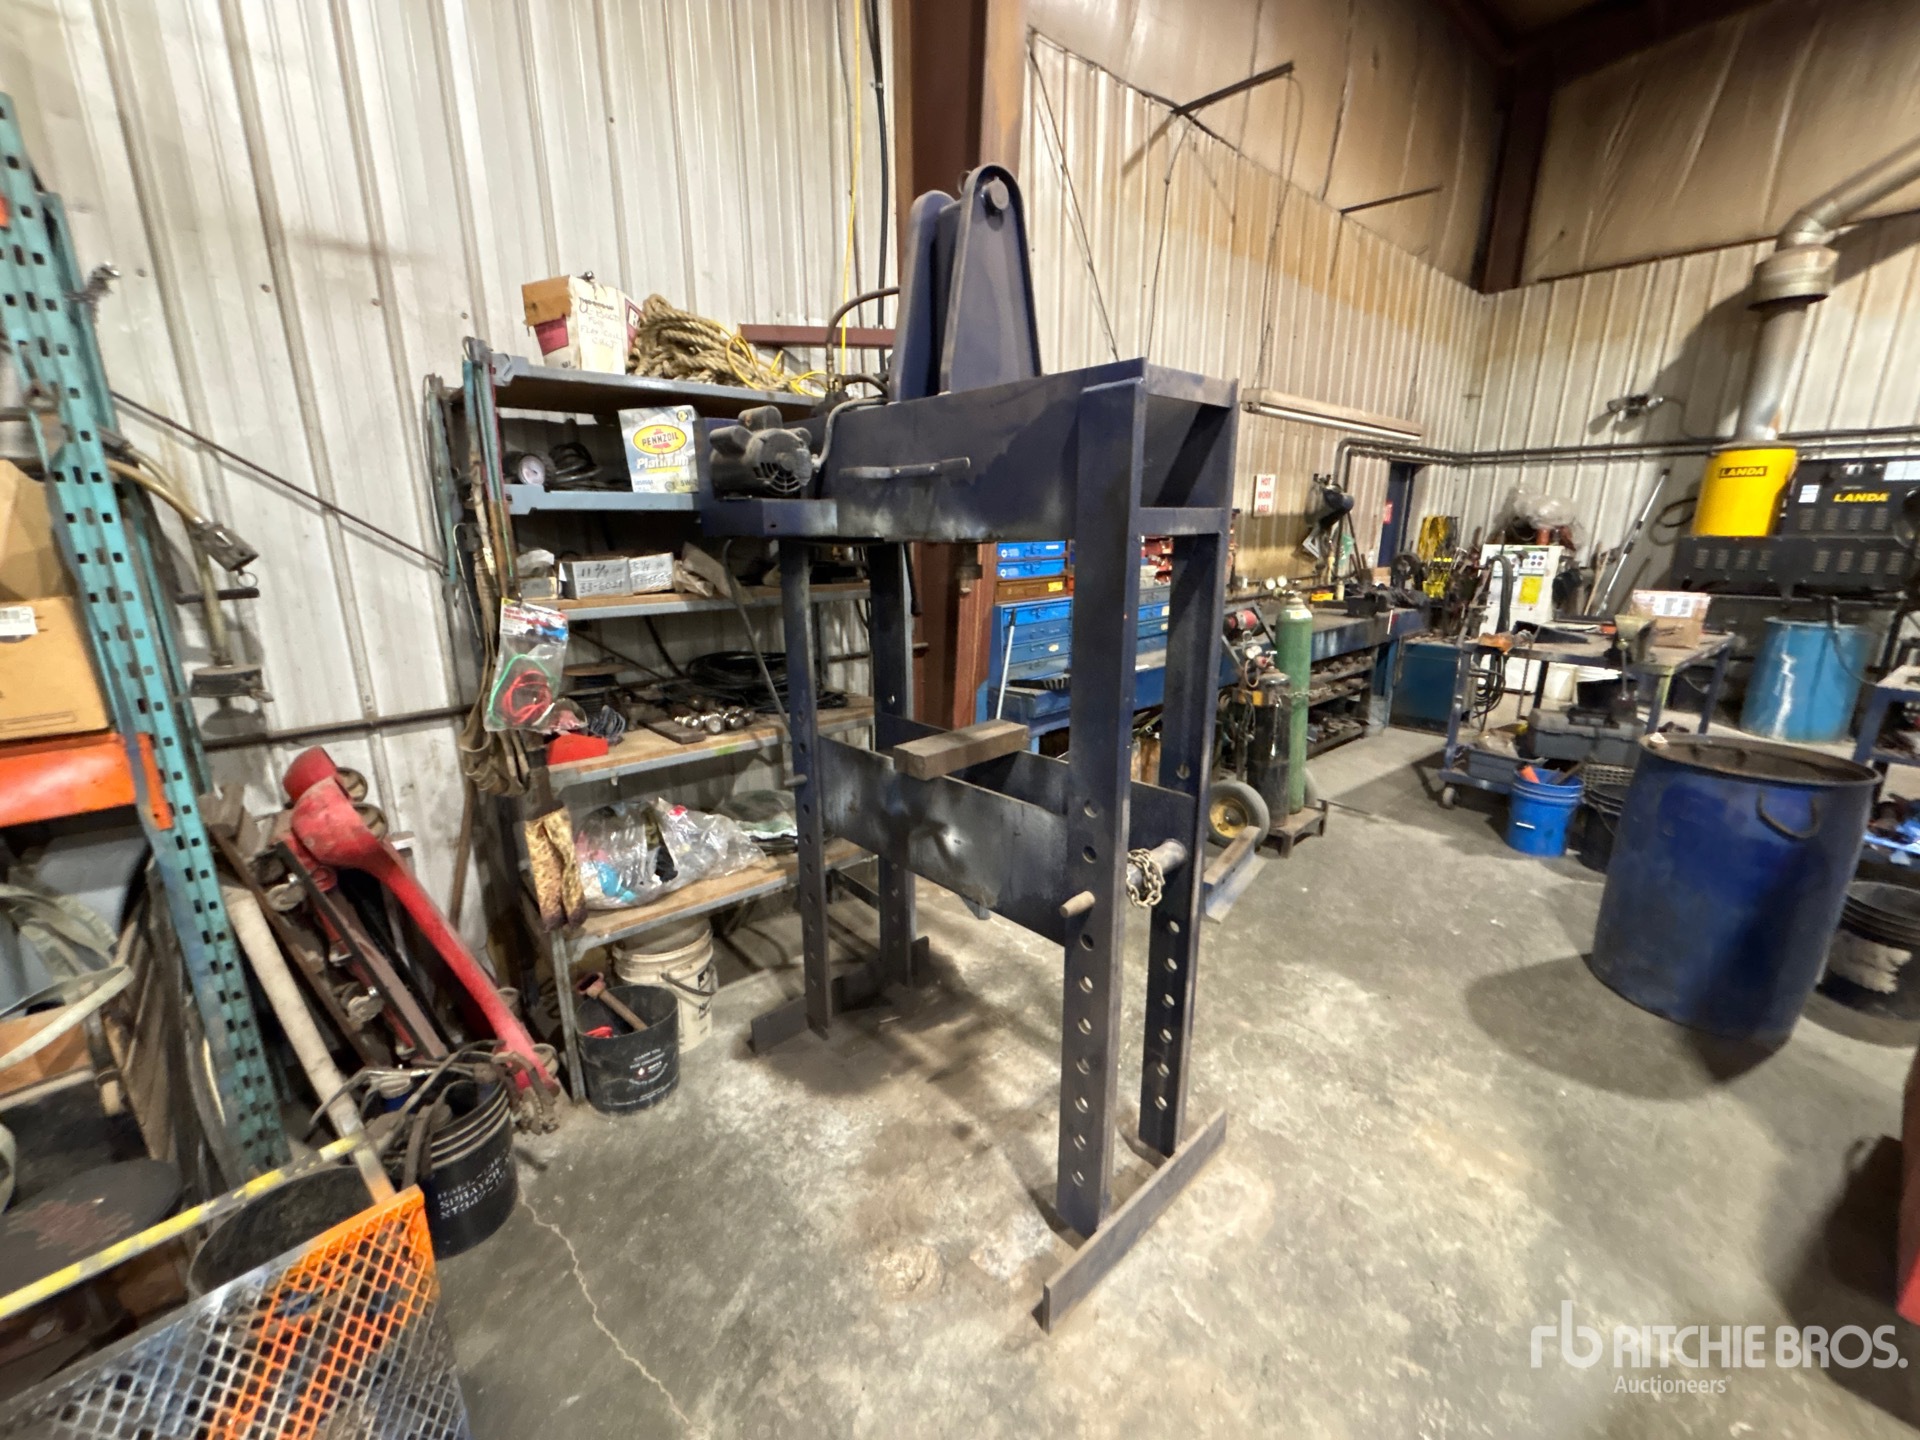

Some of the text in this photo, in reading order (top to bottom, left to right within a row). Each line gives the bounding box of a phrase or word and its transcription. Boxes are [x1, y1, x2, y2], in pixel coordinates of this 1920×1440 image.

[641, 431, 679, 446] PENNZOIL
[1721, 467, 1766, 477] LANDA
[1833, 491, 1889, 503] LANDA
